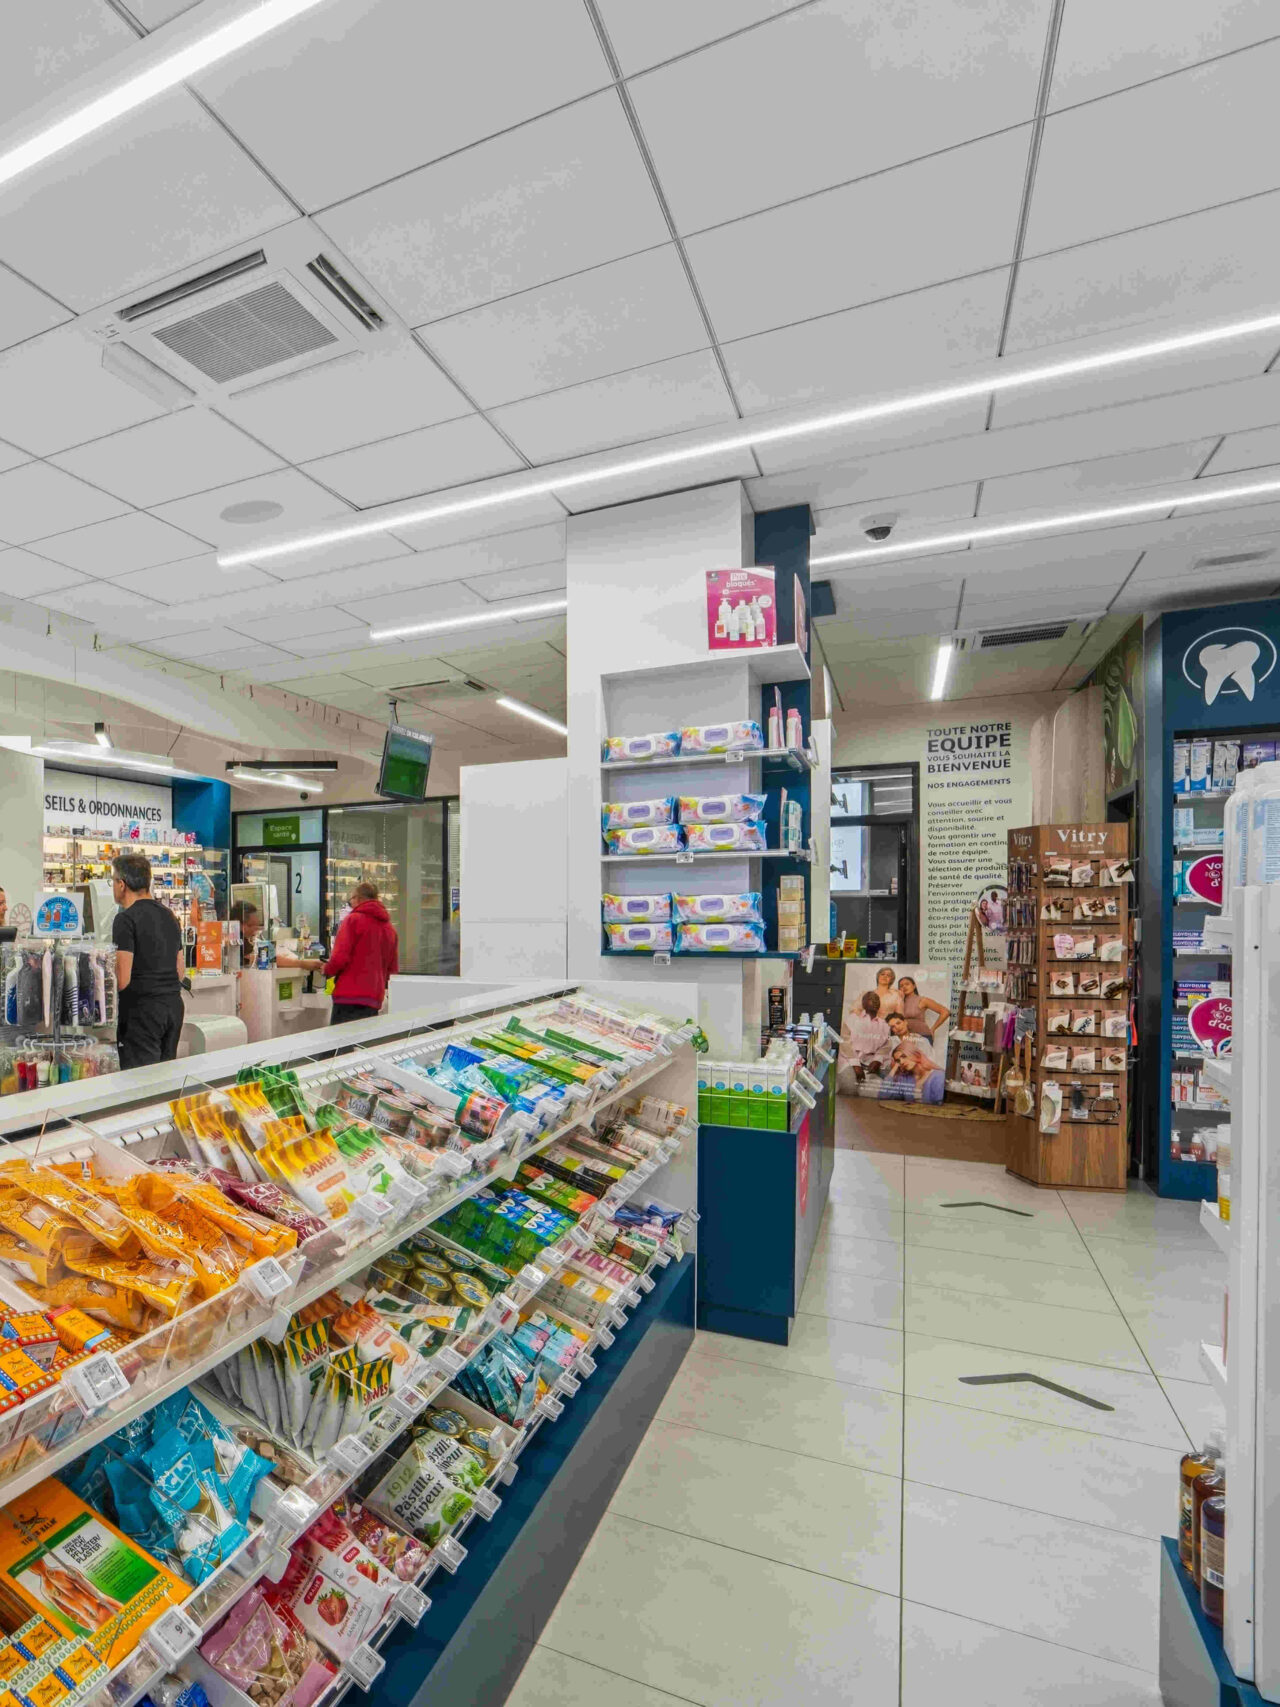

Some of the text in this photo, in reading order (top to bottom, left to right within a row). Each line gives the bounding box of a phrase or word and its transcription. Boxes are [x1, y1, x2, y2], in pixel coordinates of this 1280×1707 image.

[927, 722, 1012, 738] TOUTE NOTRE
[928, 732, 1012, 753] EQUIPE
[952, 751, 997, 760] SOUHAITE
[928, 758, 1011, 773] BIENVENUE
[946, 778, 1011, 788] ENGAGEMENTS
[78, 798, 87, 814] &
[89, 800, 162, 822] ORDONNANCES
[948, 799, 982, 807] accueillir
[270, 824, 293, 832] Espace
[948, 832, 979, 841] garantir
[1013, 834, 1033, 848] Vitry
[1056, 829, 1109, 845] Vitry
[221, 869, 228, 892] 3
[295, 872, 302, 894] 2
[303, 1152, 337, 1179] SAWES
[386, 1467, 415, 1499] 1912
[70, 1533, 101, 1559] PFLASTER/
[76, 1543, 103, 1564] PLASTER
